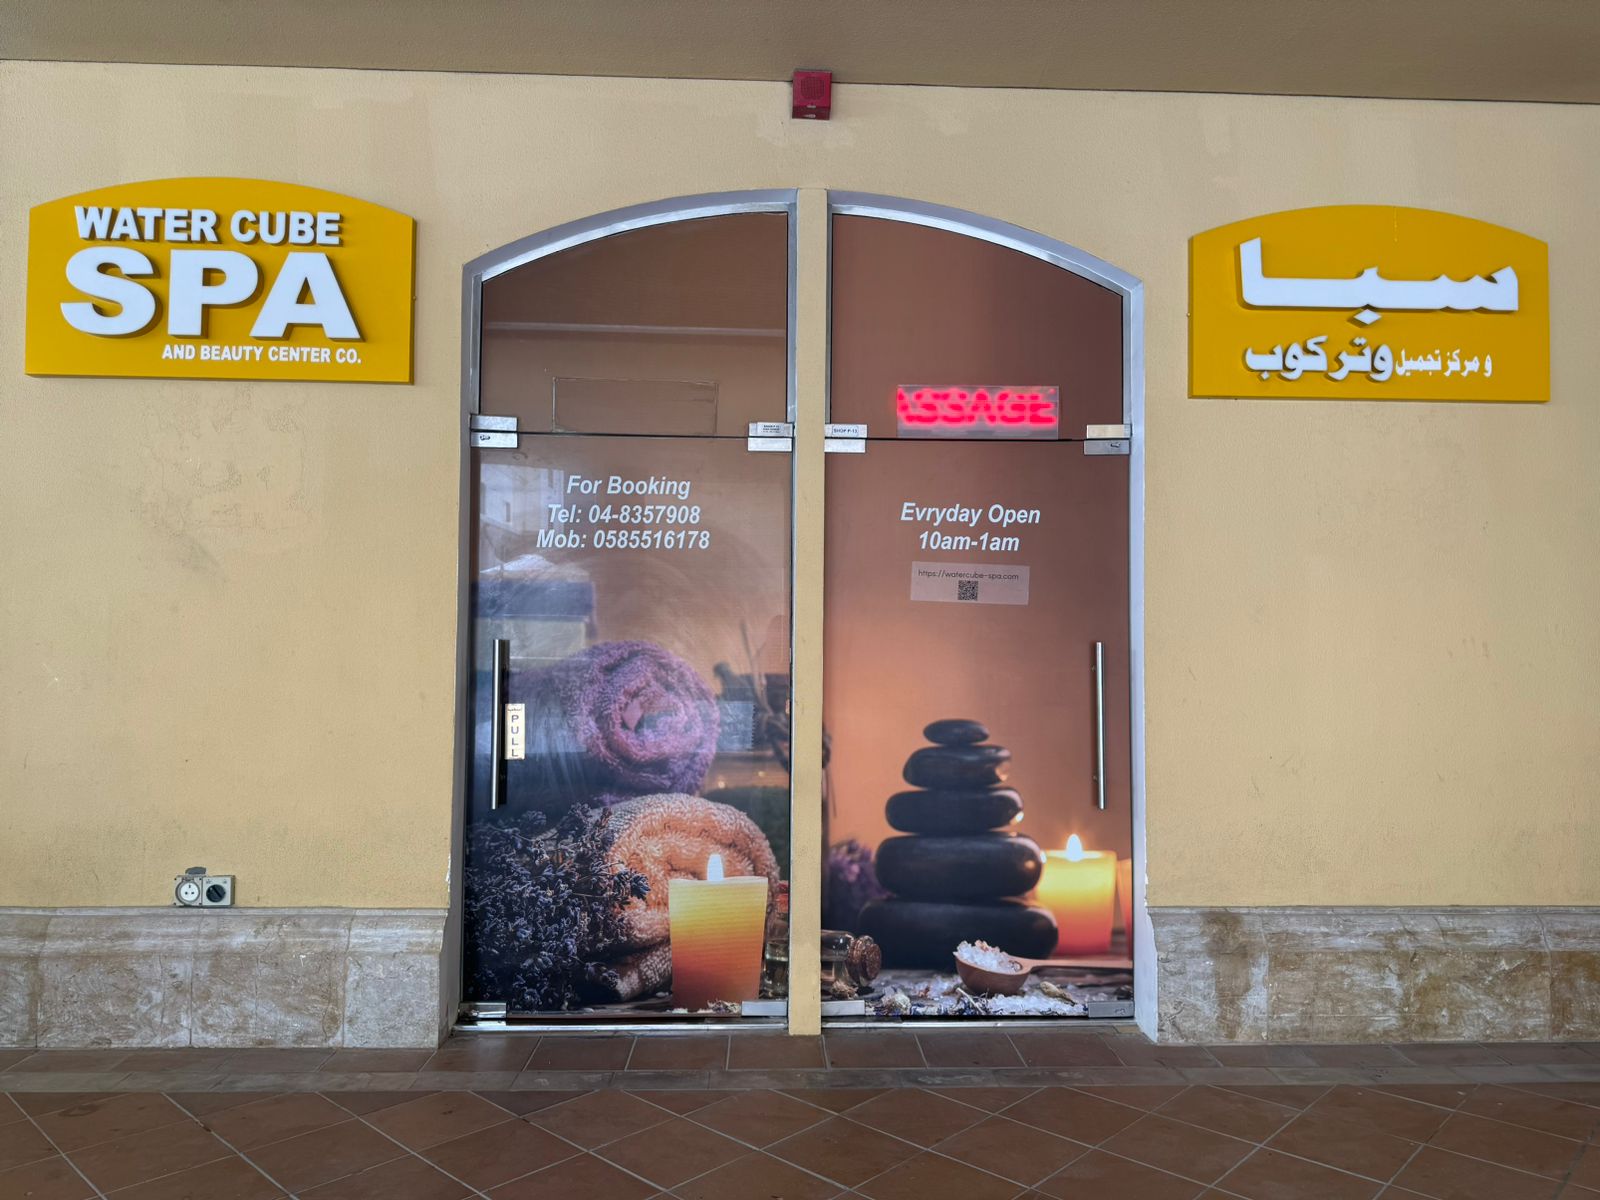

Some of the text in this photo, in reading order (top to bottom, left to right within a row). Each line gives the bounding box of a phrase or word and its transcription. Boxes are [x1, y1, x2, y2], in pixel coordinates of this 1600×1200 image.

[74, 205, 341, 245] WATER CUBE
[60, 245, 361, 339] SPA
[1239, 237, 1519, 325] سبا
[162, 344, 362, 364] AND BEAUTY CENTER CO.
[1395, 349, 1442, 376] تجميل
[1444, 349, 1480, 377] مركز
[566, 475, 691, 500] For Booking
[548, 504, 701, 524] Tel: 04-8357908
[900, 502, 1041, 527] Evryday Open
[536, 529, 710, 550] Mob: 0585516178
[919, 531, 1020, 551] 10am-1am
[918, 569, 1019, 581] https://watercube-spa.com
[511, 714, 520, 757] PULL
